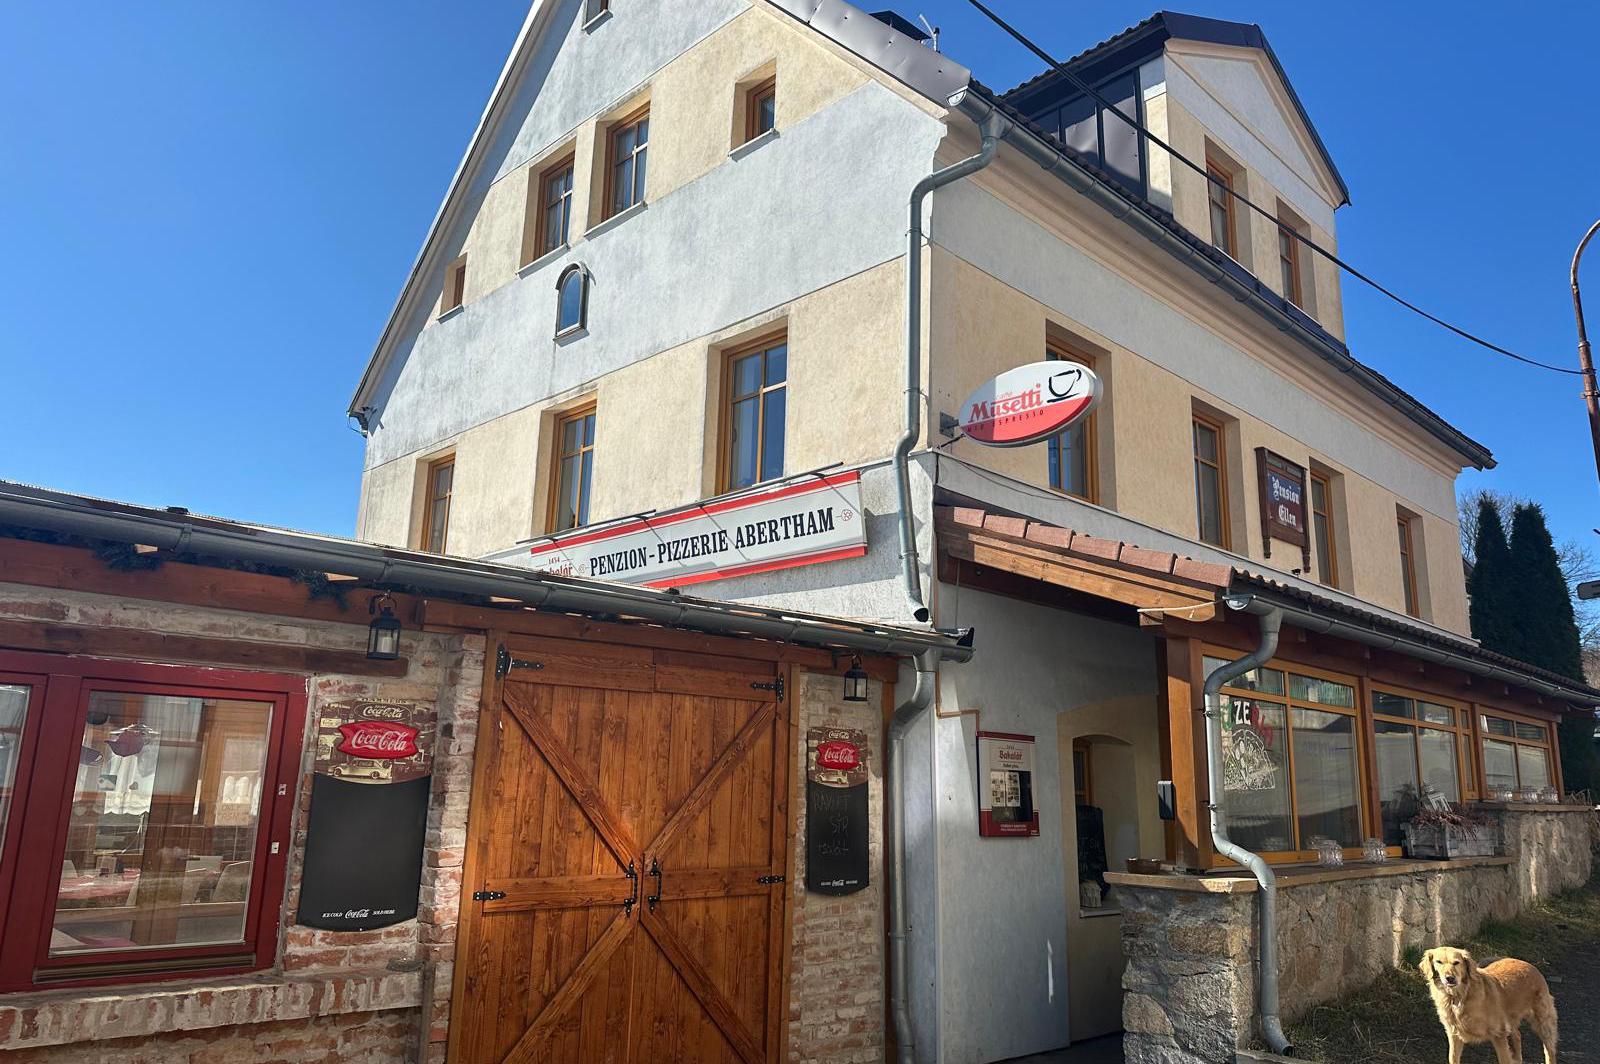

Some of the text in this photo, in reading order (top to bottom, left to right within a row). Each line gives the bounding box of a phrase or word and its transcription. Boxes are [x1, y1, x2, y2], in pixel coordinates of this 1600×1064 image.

[968, 383, 1043, 423] Musetti
[735, 507, 835, 549] ABERTHAM
[351, 728, 409, 752] Coca-Cola
